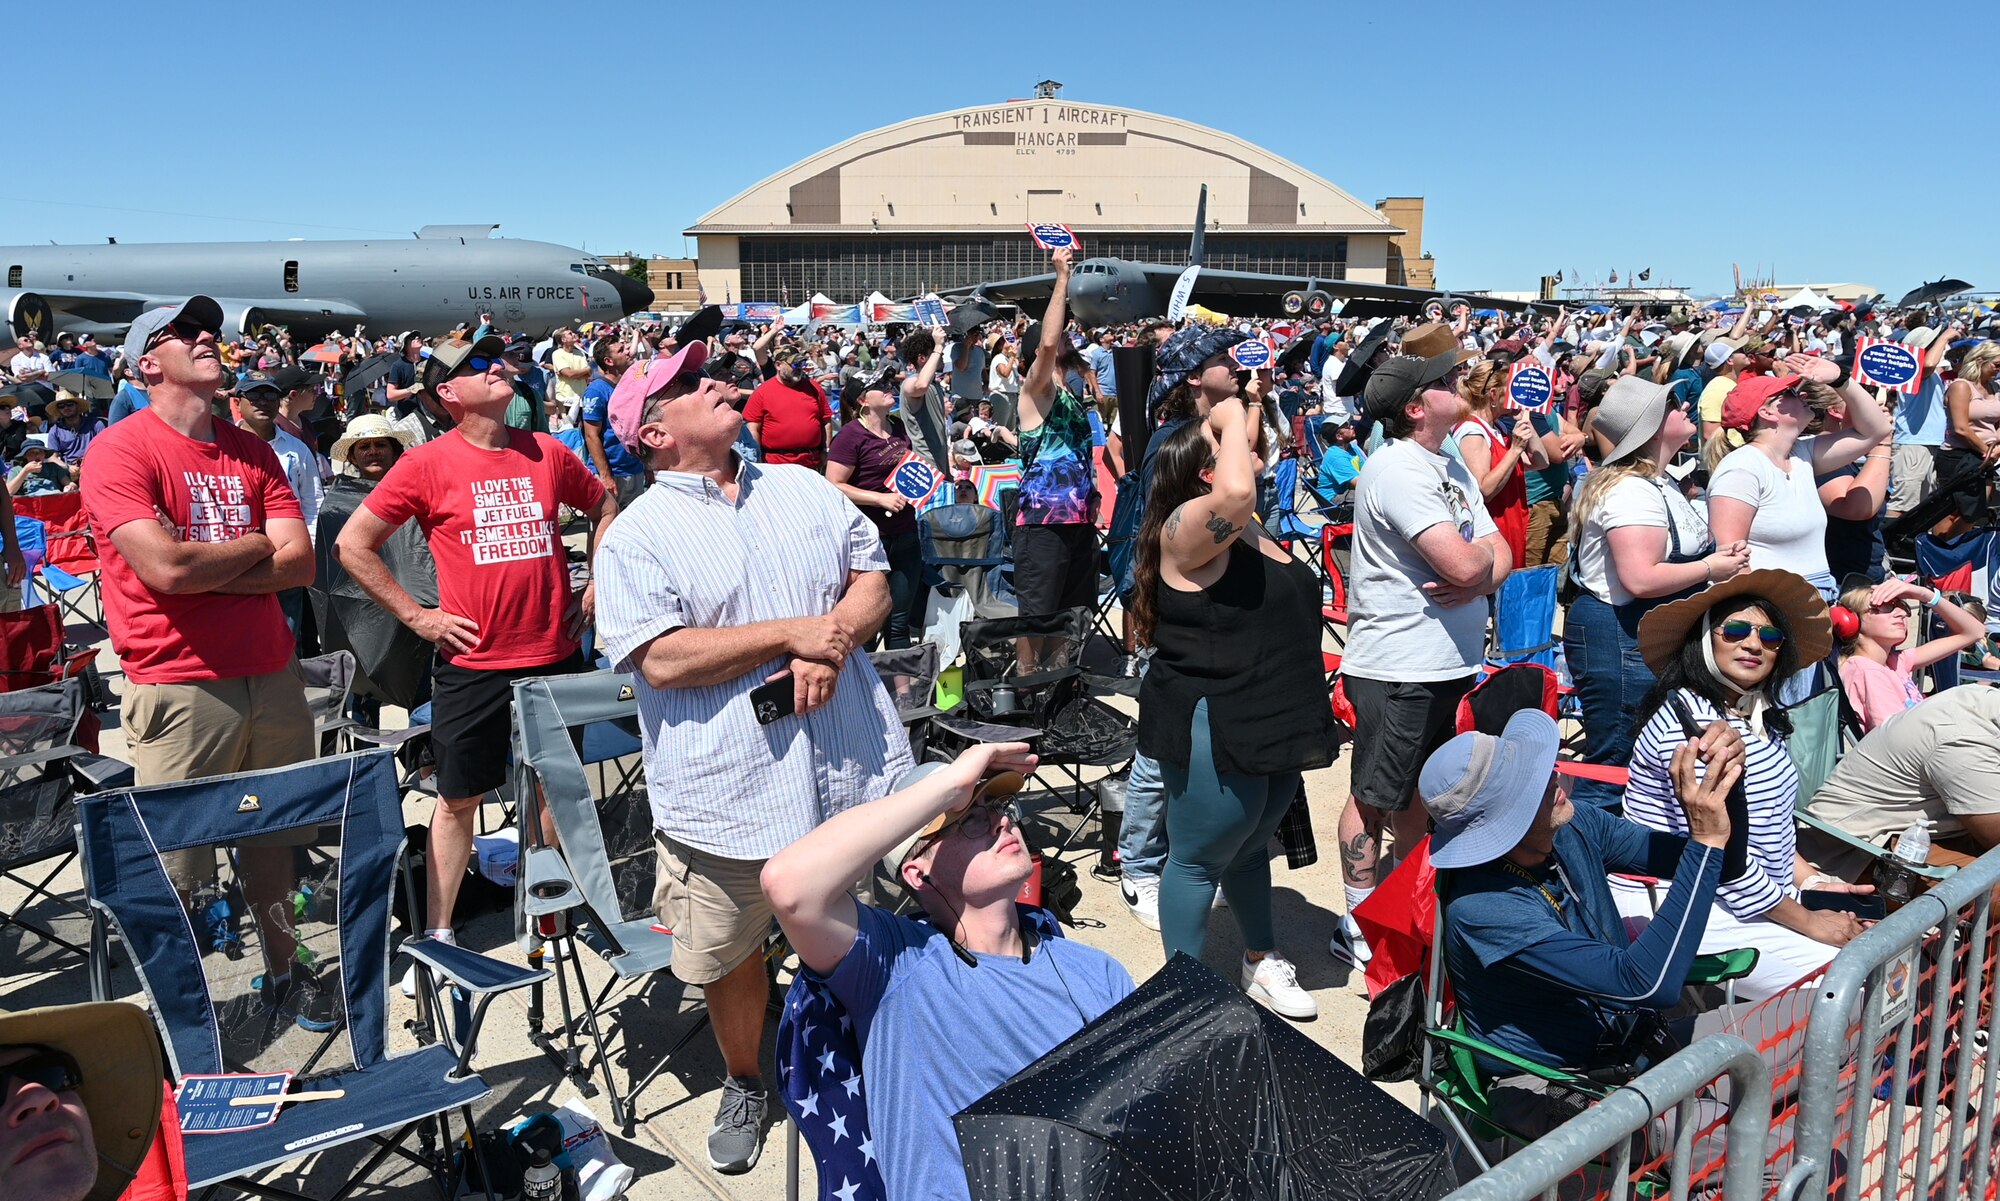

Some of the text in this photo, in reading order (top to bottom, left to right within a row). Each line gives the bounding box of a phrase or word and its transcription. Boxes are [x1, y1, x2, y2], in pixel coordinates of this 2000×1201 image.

[953, 107, 1128, 129] TRANSIENT 1 AIRCRAFT
[1017, 132, 1076, 146] HANGAR
[468, 287, 575, 300] U.S. AIR FORCE
[1882, 346, 1899, 354] Take
[1887, 353, 1909, 361] health
[1888, 359, 1914, 369] heights
[189, 471, 217, 490] LOE
[218, 475, 244, 490] THE
[470, 477, 533, 494] I LOVE THE
[190, 487, 244, 504] SML OF
[474, 489, 535, 508] SMELL OF
[197, 506, 244, 522] JET EL
[481, 506, 536, 523] JET FUEL
[189, 525, 236, 542] SMELS
[460, 520, 555, 545] IT SMELLS LIKE
[478, 537, 548, 561] FREEDOM
